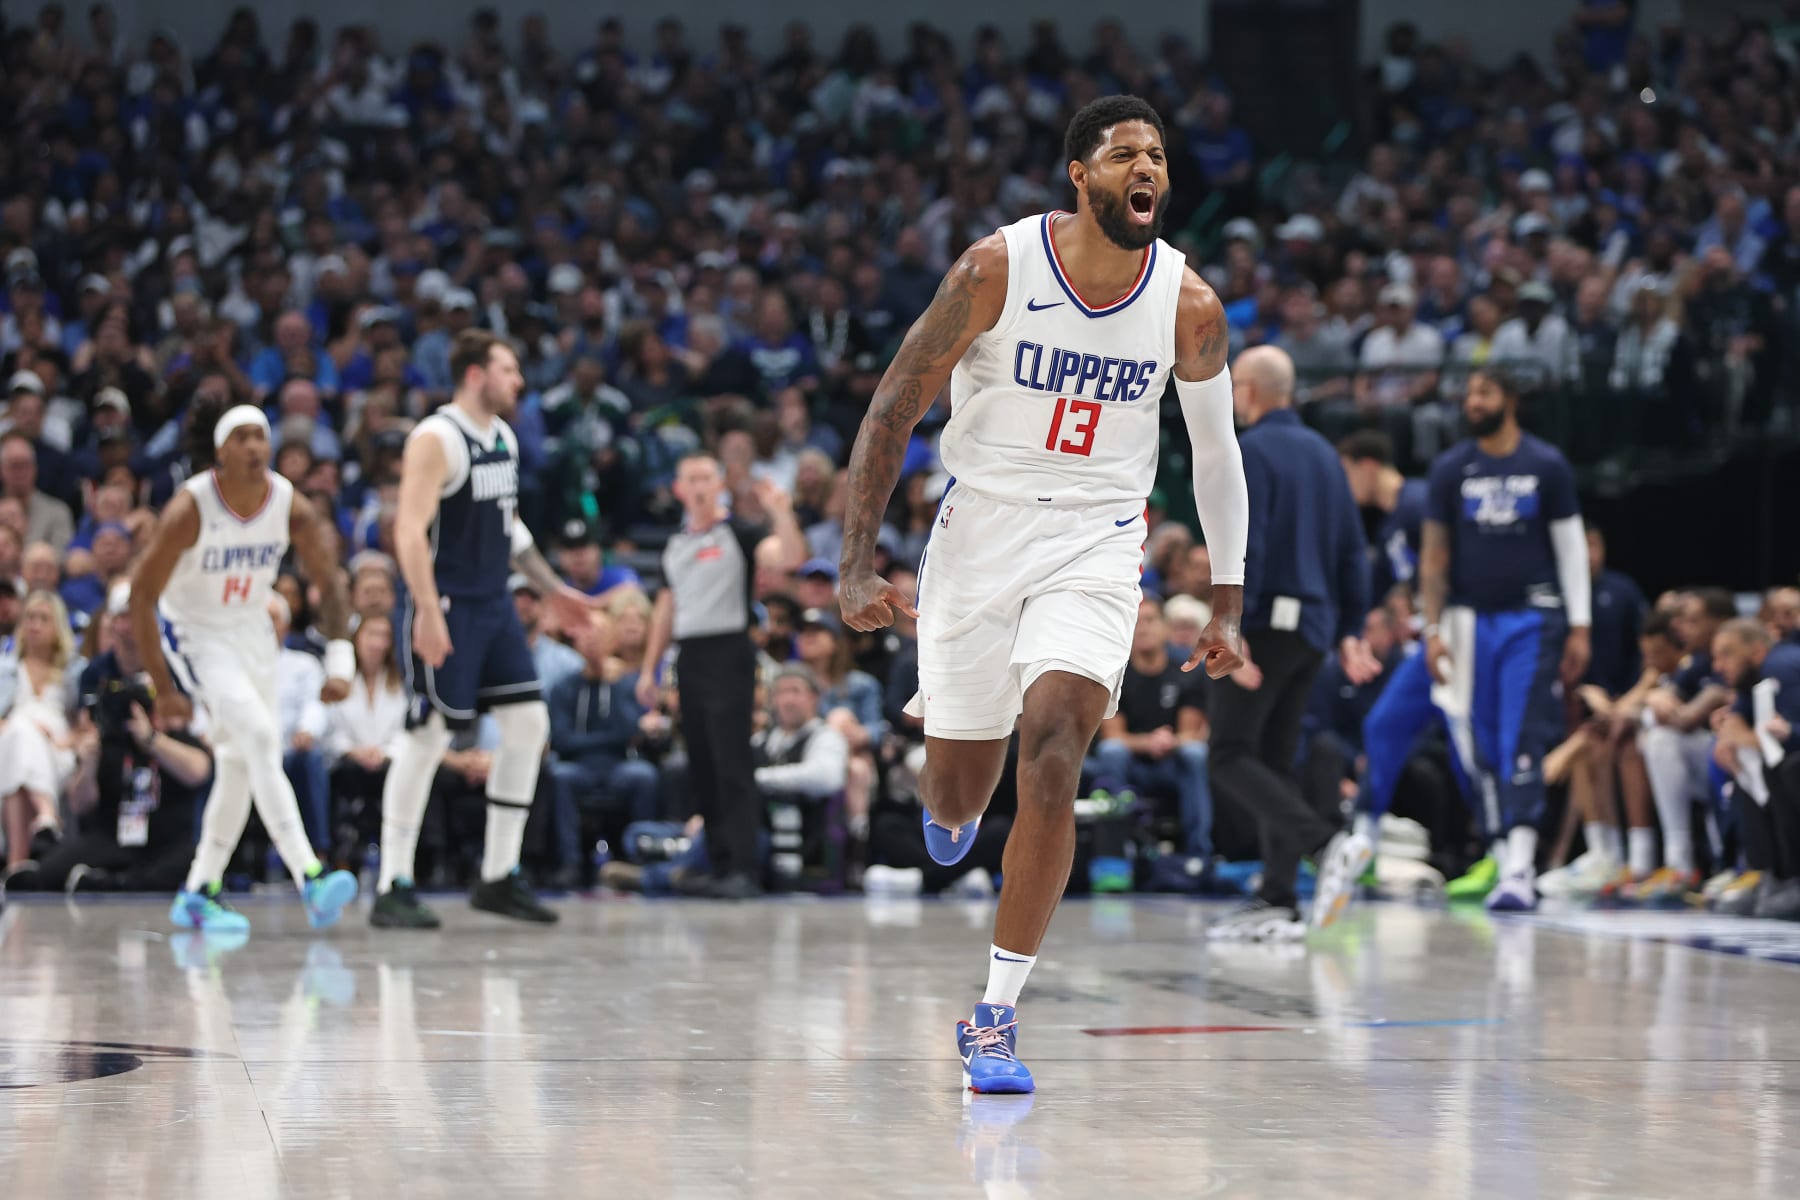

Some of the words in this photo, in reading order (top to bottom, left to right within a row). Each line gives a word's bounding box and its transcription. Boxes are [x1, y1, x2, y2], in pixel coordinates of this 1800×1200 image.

[1014, 340, 1157, 402] CLIPPERS
[1045, 398, 1102, 457] 13
[202, 541, 281, 573] CLIPPERS
[222, 574, 253, 606] 14
